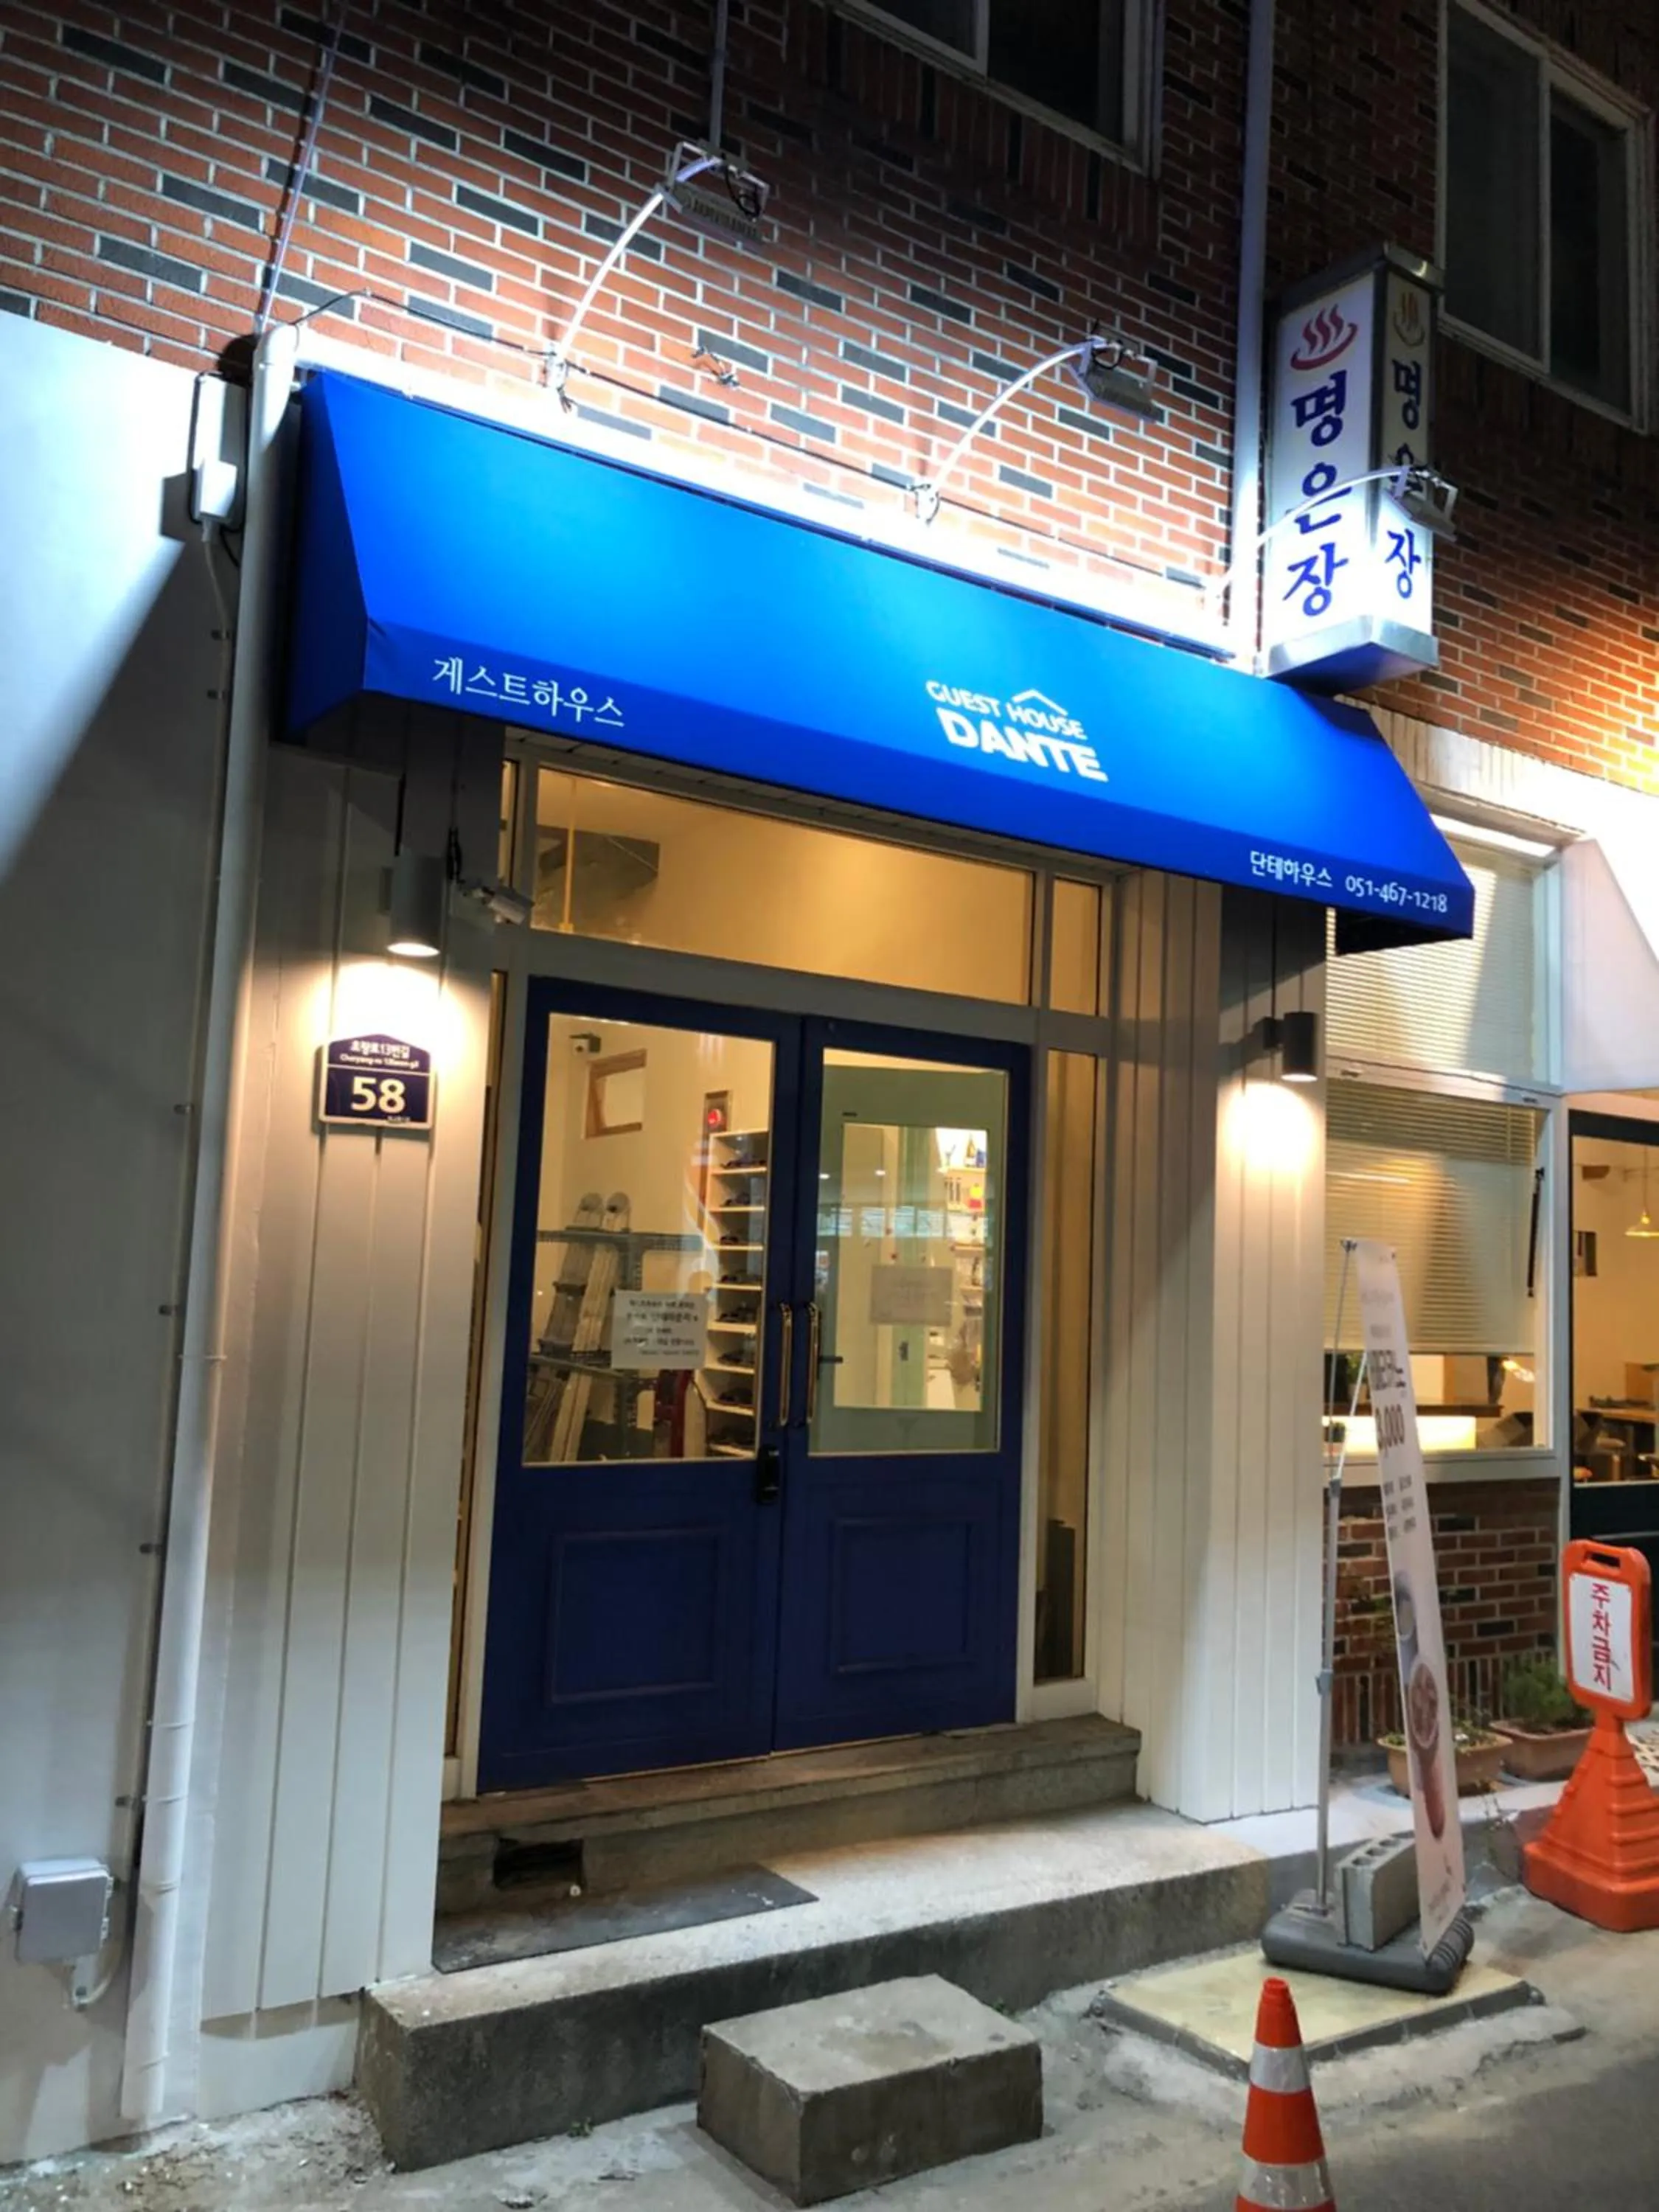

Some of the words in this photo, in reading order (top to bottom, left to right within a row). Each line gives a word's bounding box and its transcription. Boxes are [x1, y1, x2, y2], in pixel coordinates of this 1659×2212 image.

[1283, 369, 1352, 617] 명은장
[432, 656, 625, 727] 게스트하우스
[925, 680, 1001, 717] GUEST
[1005, 700, 1088, 740] HOUSE
[936, 706, 1108, 783] DANTE
[1250, 850, 1333, 888] 단테하우스
[1344, 874, 1448, 913] 051-467-1218
[350, 1076, 406, 1114] 58
[1590, 1583, 1612, 1691] 주차금지
